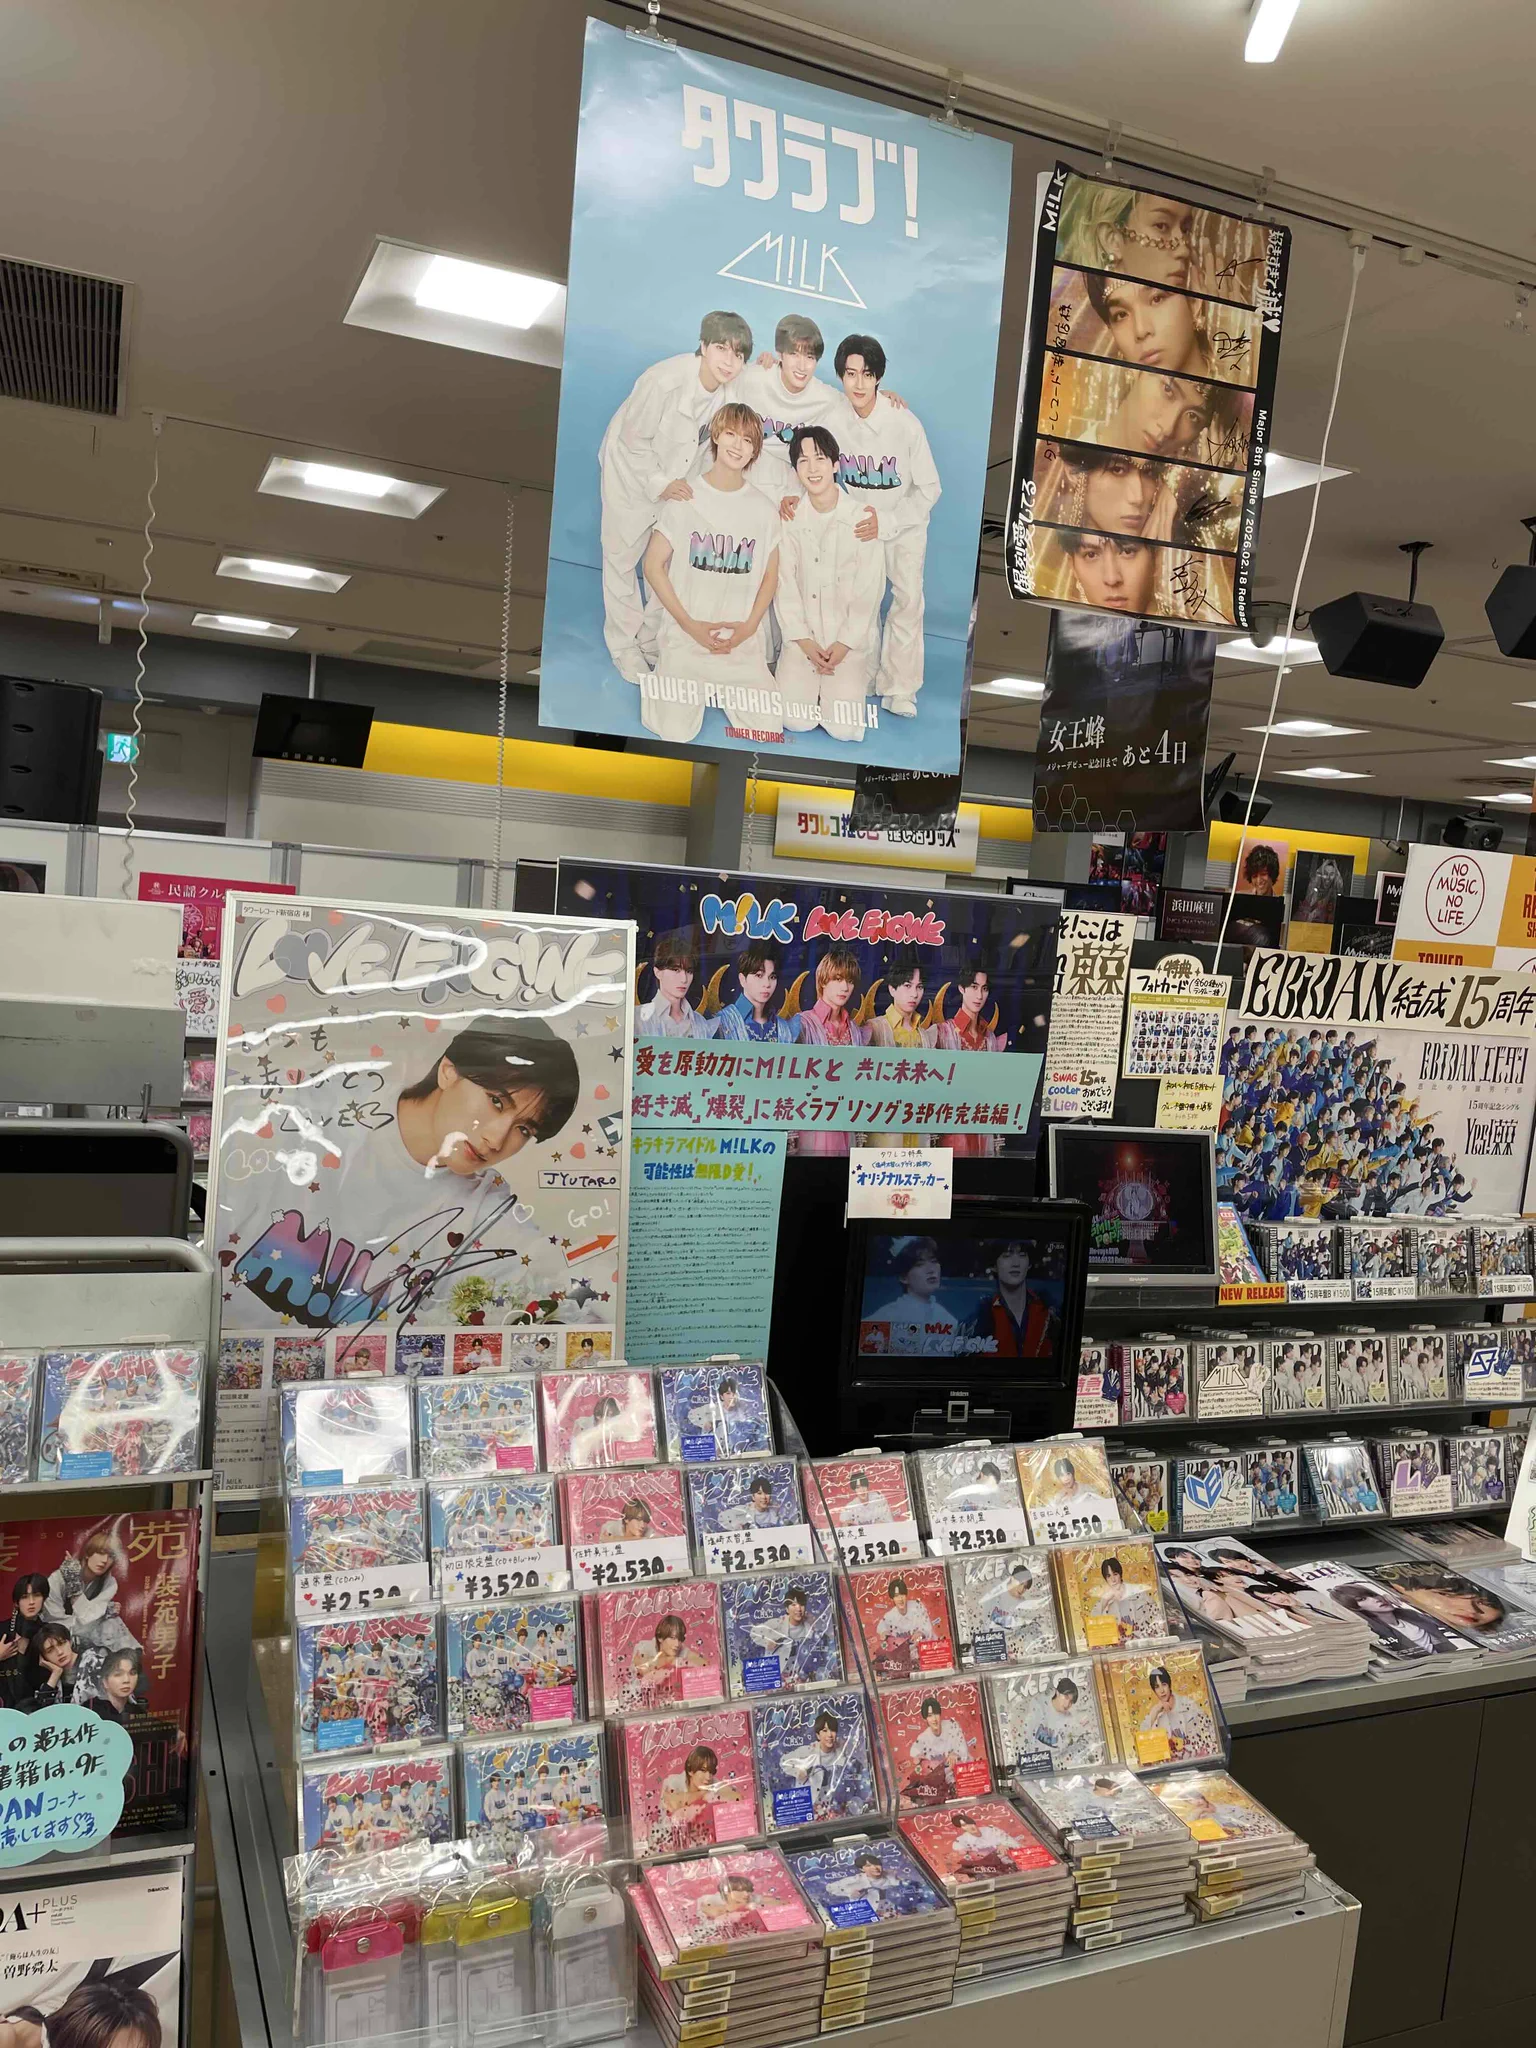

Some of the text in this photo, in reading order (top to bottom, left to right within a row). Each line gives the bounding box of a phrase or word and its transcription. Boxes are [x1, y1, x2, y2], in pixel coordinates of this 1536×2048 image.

[1042, 168, 1067, 232] M!LK
[1256, 409, 1267, 443] Major
[1255, 445, 1264, 467] 8th
[1248, 468, 1261, 505] Single
[1240, 518, 1255, 585] 2026.02.18
[1236, 587, 1249, 628] Release
[637, 672, 698, 706] TOWER
[704, 681, 783, 716] RECORDS
[834, 699, 879, 730] M!LK
[725, 725, 785, 744] TOWER RECORDS
[1048, 715, 1106, 754] 女王蜂
[1452, 863, 1469, 877] NO
[1437, 876, 1479, 896] MUSIC,
[1446, 895, 1463, 908] NO
[700, 892, 799, 944] M!LK
[1437, 909, 1465, 926] LIFE.
[855, 1058, 956, 1085] 共に未来へ!
[1053, 1071, 1078, 1083] SWAG
[544, 1171, 617, 1187] JYUTARO
[856, 1171, 945, 1187] オリジナルステッカー
[567, 1198, 613, 1228] GO!
[1220, 1286, 1285, 1300] NEW RELEASE
[127, 1521, 189, 1563] 苑
[151, 1572, 182, 1680] 装苑男子
[42, 1894, 79, 1909] PLUS
